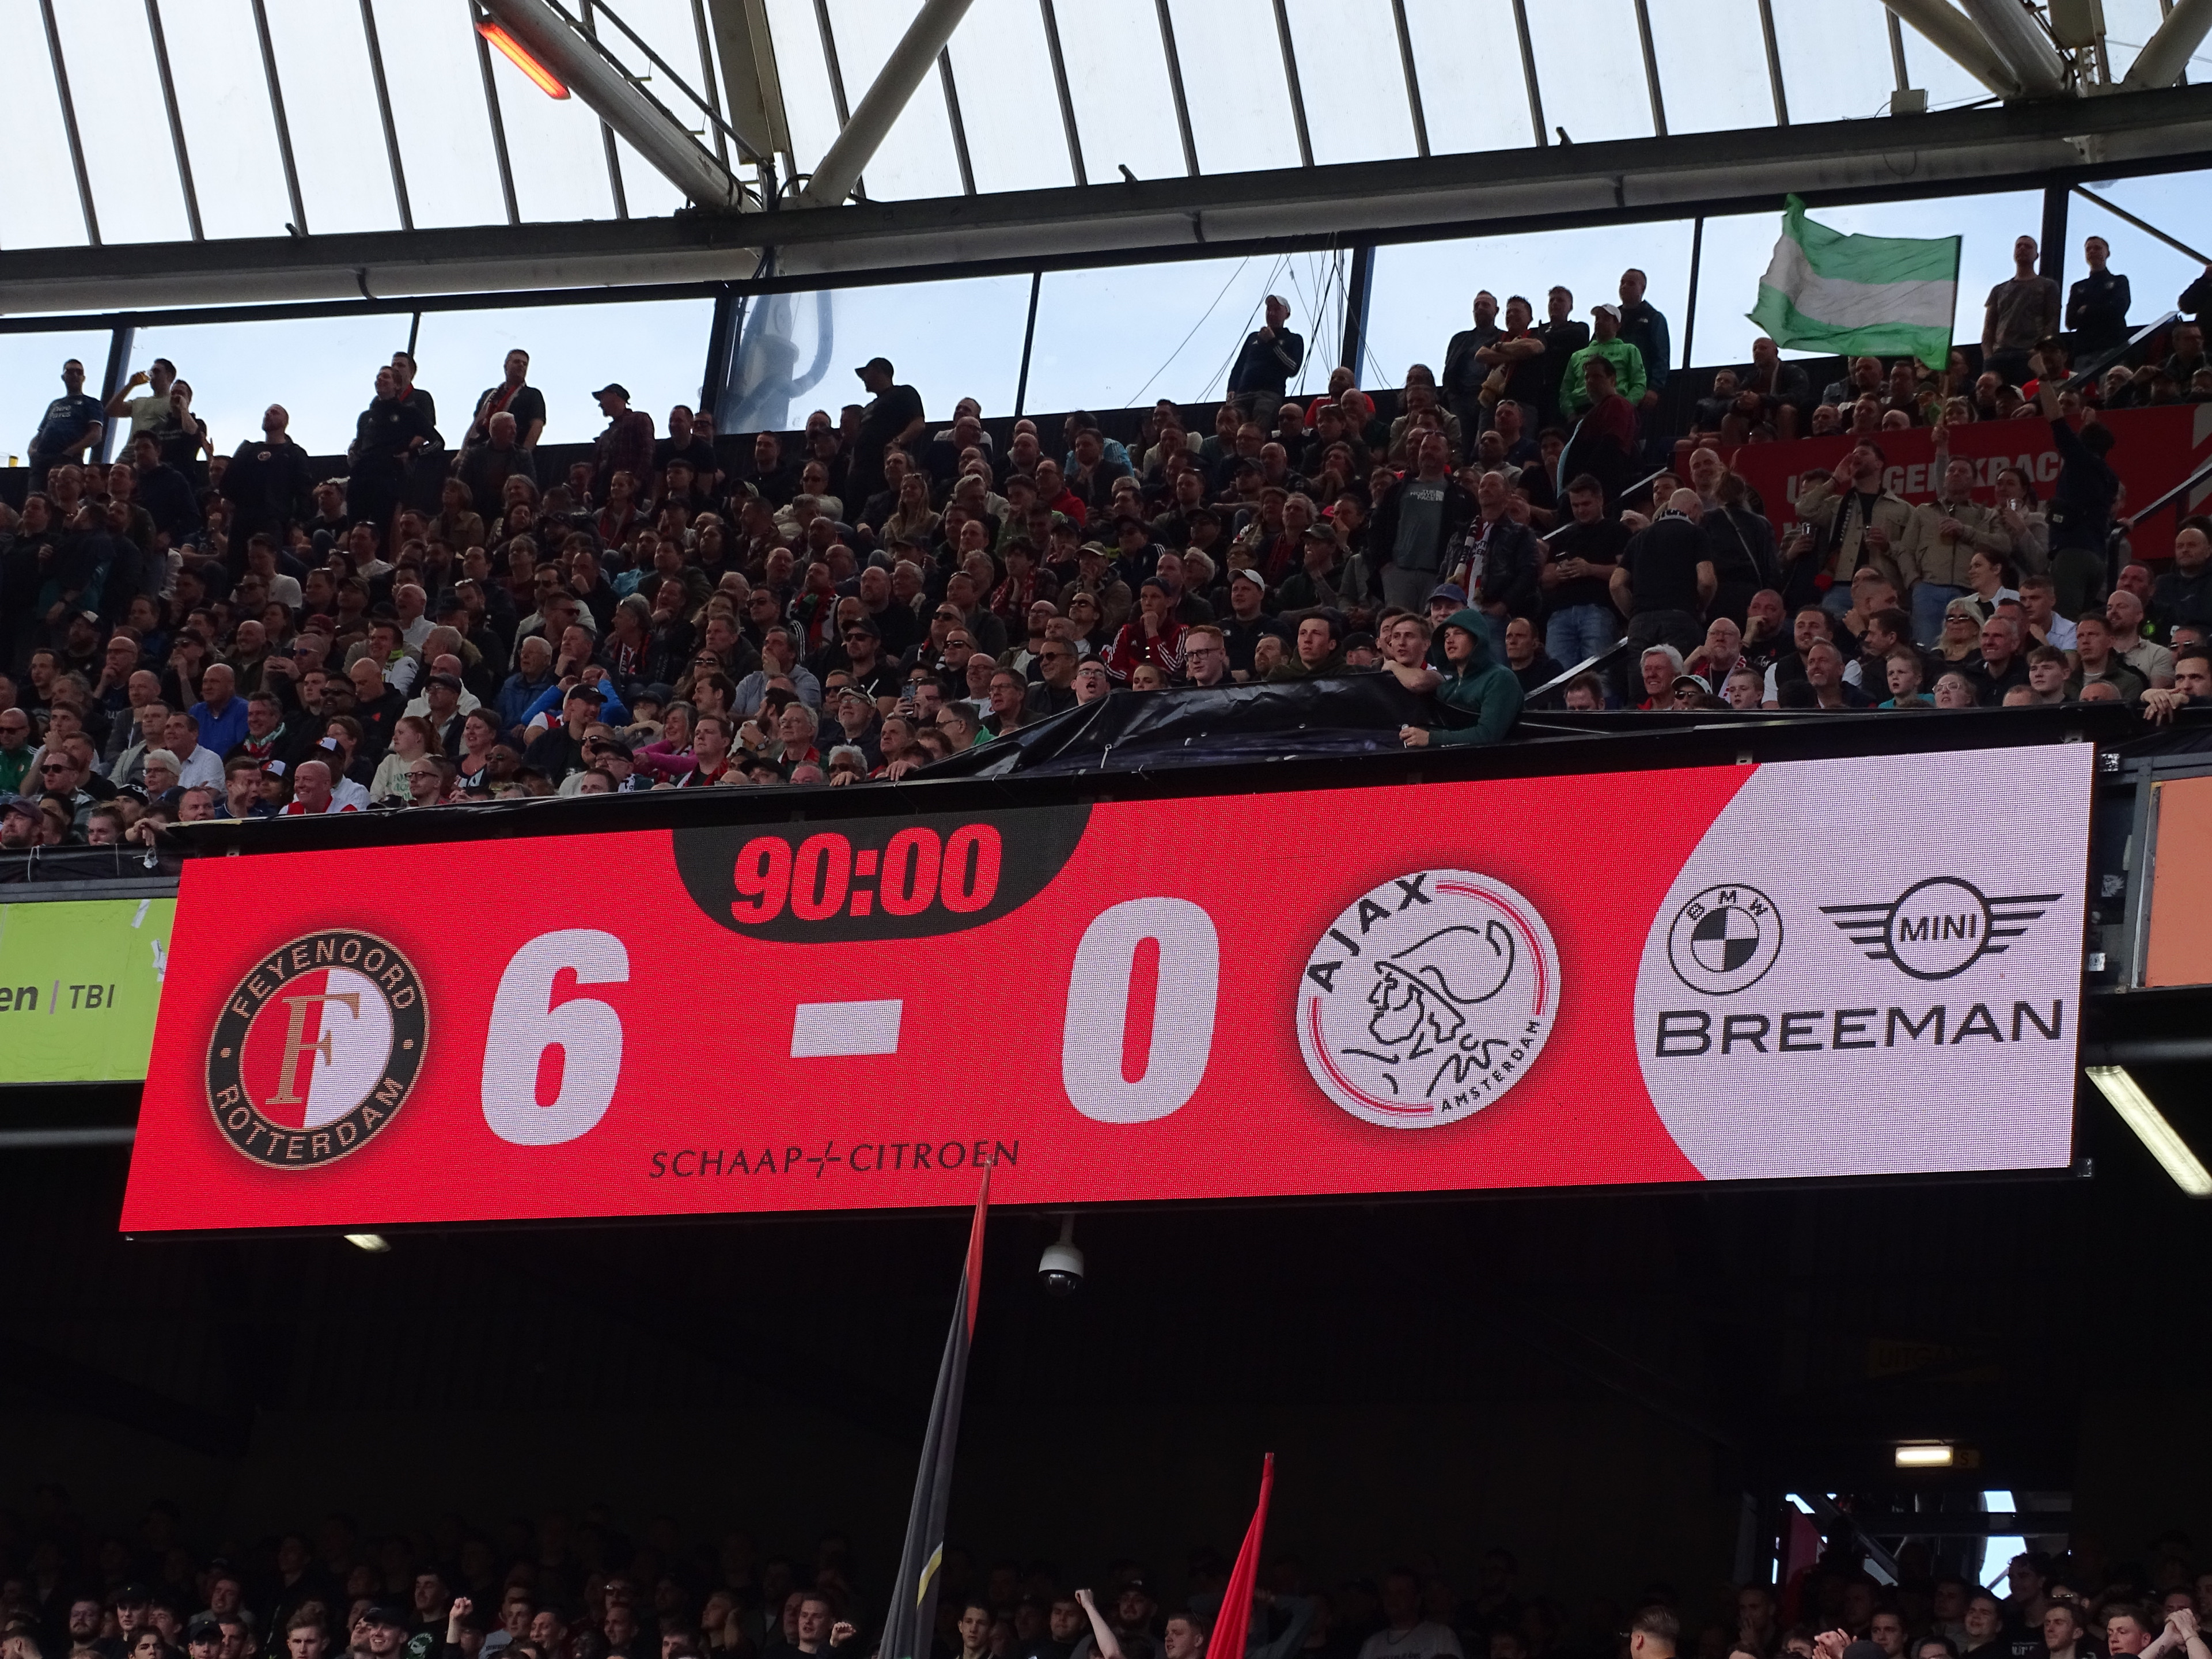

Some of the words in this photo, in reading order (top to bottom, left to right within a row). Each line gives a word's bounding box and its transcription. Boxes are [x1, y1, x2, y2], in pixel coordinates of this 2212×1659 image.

[730, 823, 1002, 924] 90:00
[1687, 890, 1768, 920] BMW
[1307, 873, 1432, 993] AJAX
[1899, 914, 1977, 942] MINI
[69, 984, 115, 1009] TBI
[232, 938, 416, 1018] FEYENOORD
[266, 993, 361, 1105] F
[480, 928, 630, 1146] 6
[1062, 896, 1220, 1123] 0
[1655, 999, 2063, 1058] BREEMAN
[1441, 1021, 1540, 1112] AMSTERDAM
[217, 1076, 403, 1159] ROTTERDAM
